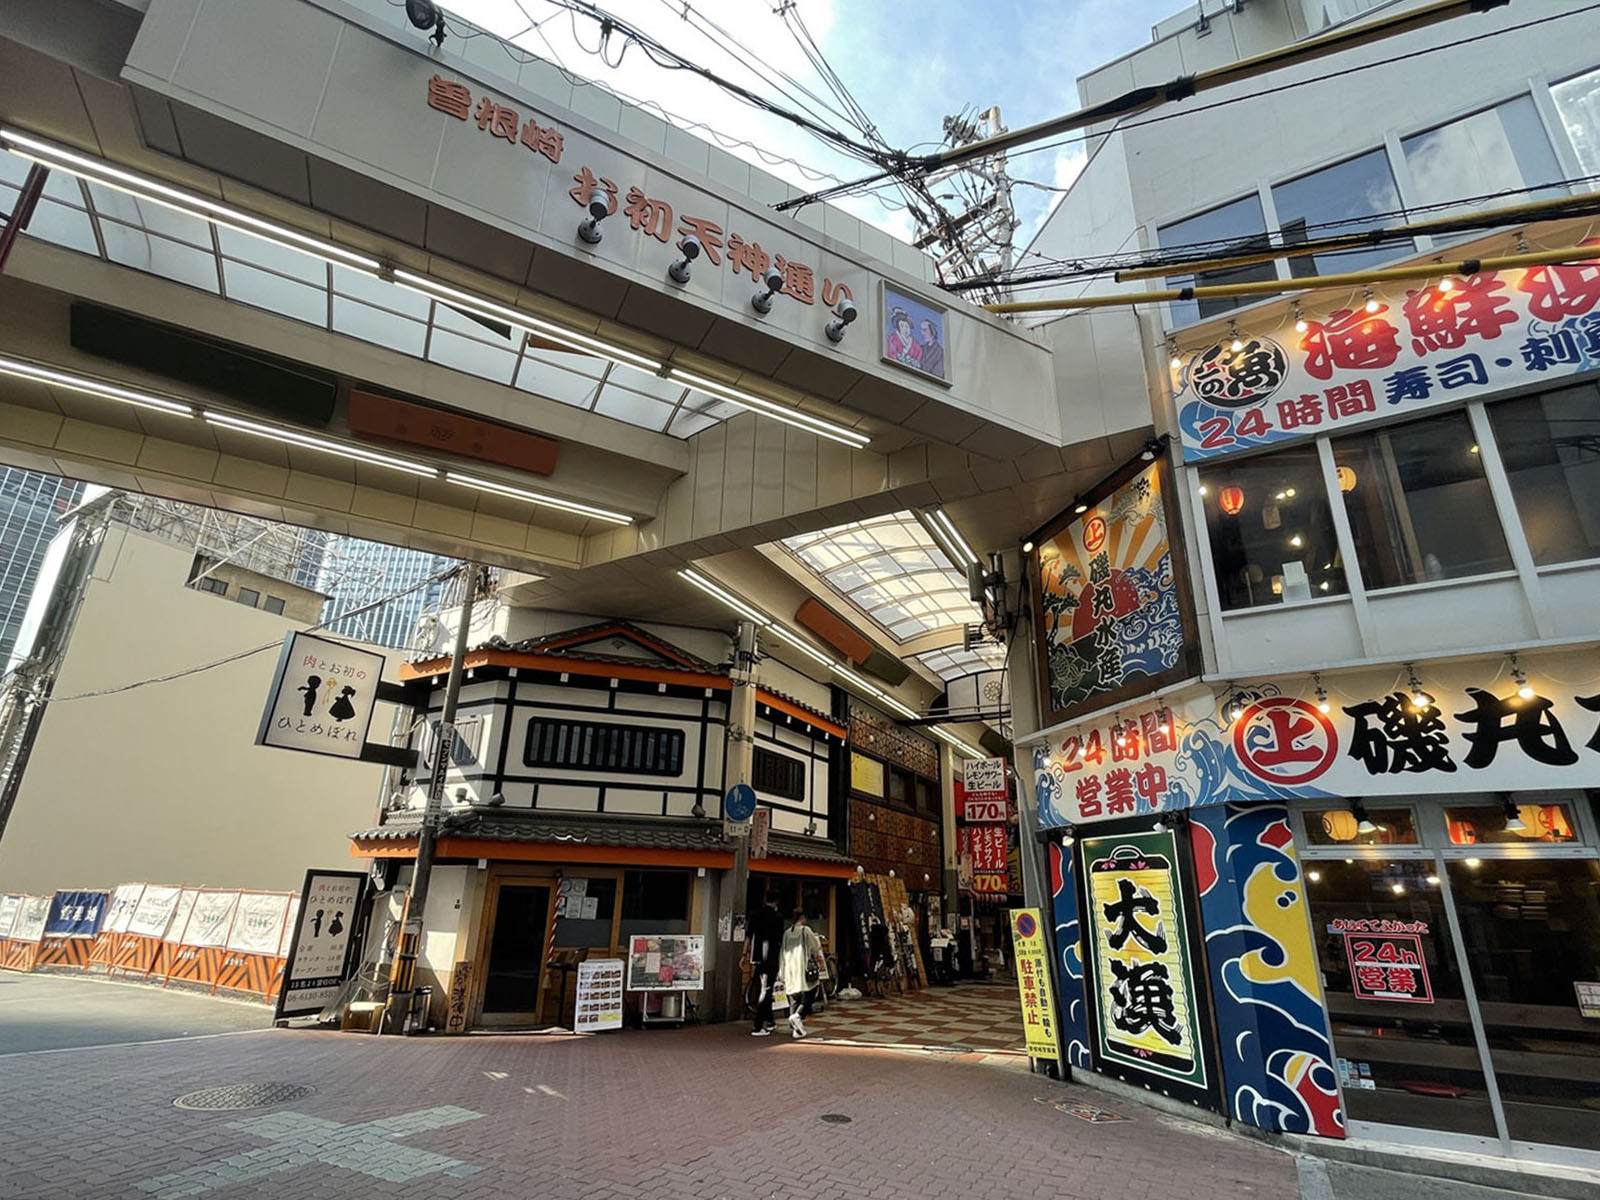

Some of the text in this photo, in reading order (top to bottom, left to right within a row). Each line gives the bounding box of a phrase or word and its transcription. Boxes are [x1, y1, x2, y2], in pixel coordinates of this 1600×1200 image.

[427, 73, 854, 319] 曽根崎 お初天神通り
[1199, 377, 1377, 449] 24時間
[1089, 550, 1123, 685] 磯丸水産
[303, 654, 367, 681] 肉とお初の
[277, 716, 358, 743] ひとめぼれ
[1062, 706, 1177, 773] 24時間
[1341, 686, 1600, 776] 磯丸
[966, 760, 1002, 770] ハイボール
[966, 770, 1003, 780] レモンサワー
[968, 780, 1002, 790] 生ビール
[1076, 762, 1168, 818] 営業中
[972, 827, 983, 869] ハイボール
[983, 827, 993, 869] レモンサワー
[994, 827, 1005, 869] 生ビール
[310, 895, 354, 905] ひとめぼれ
[1333, 918, 1430, 935] あいててよかった
[1103, 877, 1183, 1046] 大漁
[1354, 941, 1418, 965] 24h
[1020, 958, 1041, 1026] 駐車禁止
[1358, 966, 1417, 993] 営業
